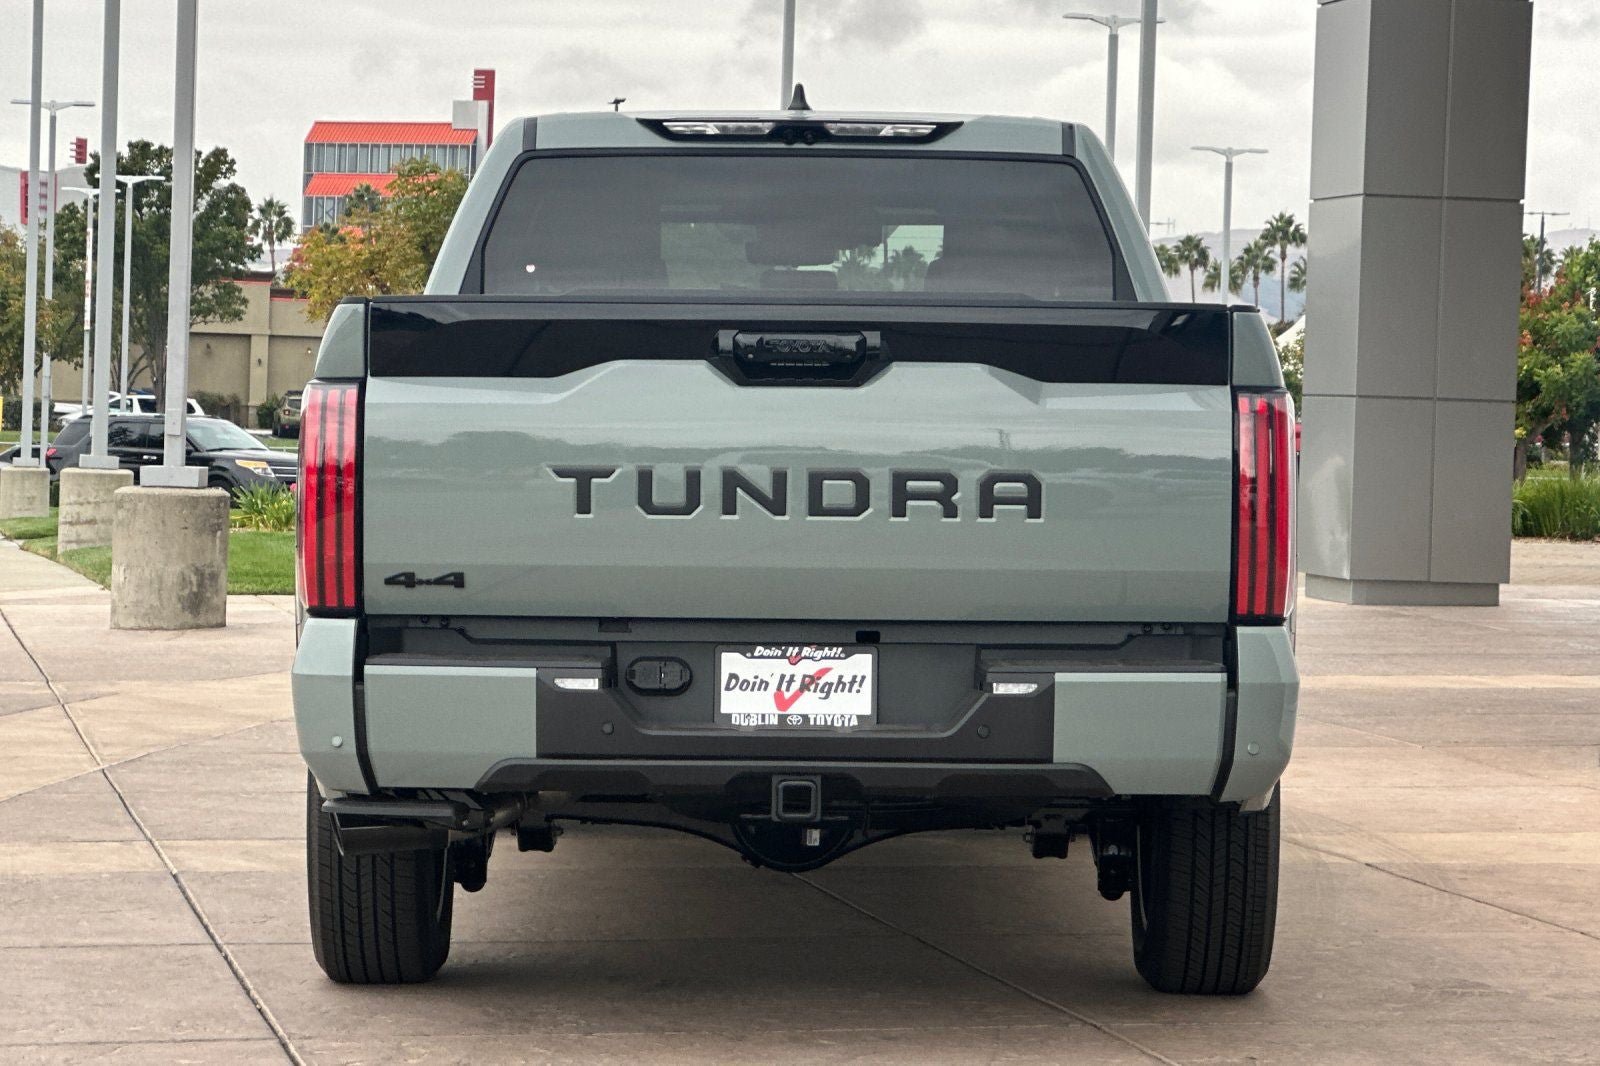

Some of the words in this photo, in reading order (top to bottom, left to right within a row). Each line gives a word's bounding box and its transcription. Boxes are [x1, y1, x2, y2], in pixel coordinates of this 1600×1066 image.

[545, 464, 1044, 522] TUNDRA
[754, 646, 785, 657] Doin'
[786, 646, 799, 657] It
[801, 646, 843, 661] Right!
[724, 672, 774, 692] Doin'
[776, 673, 796, 692] It
[800, 674, 866, 700] Right!
[731, 713, 779, 726] DUBLIN
[808, 714, 859, 727] TOYOTA
